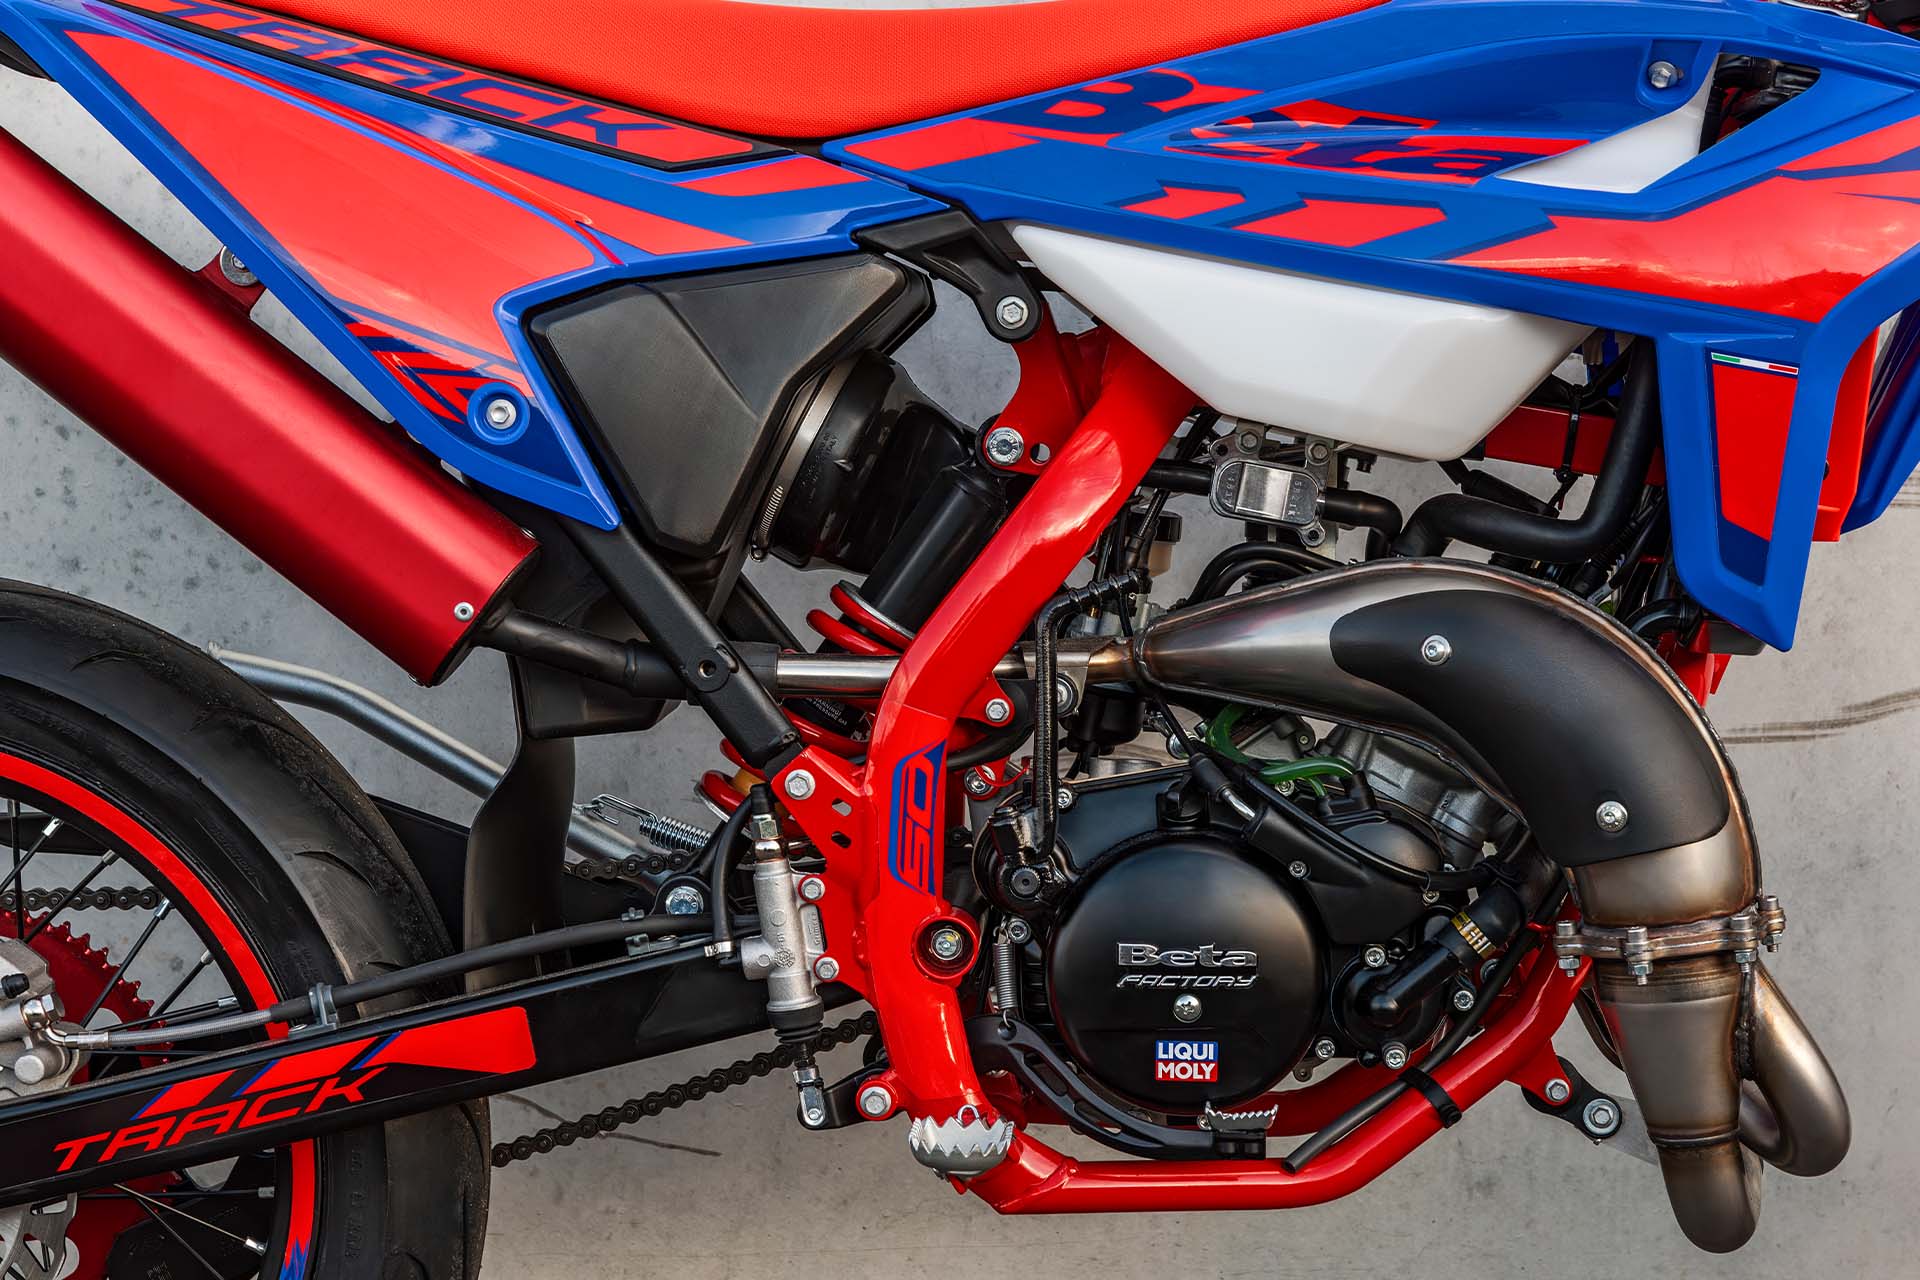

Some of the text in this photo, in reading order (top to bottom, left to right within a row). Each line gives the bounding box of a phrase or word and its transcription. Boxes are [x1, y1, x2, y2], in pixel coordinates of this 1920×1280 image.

[161, 0, 675, 147] TRACK
[1117, 943, 1257, 967] Beta
[1116, 974, 1259, 988] FACTORY
[1157, 1042, 1214, 1061] LIQUI
[1157, 1062, 1216, 1080] MOLY
[53, 1066, 388, 1172] TRACK
